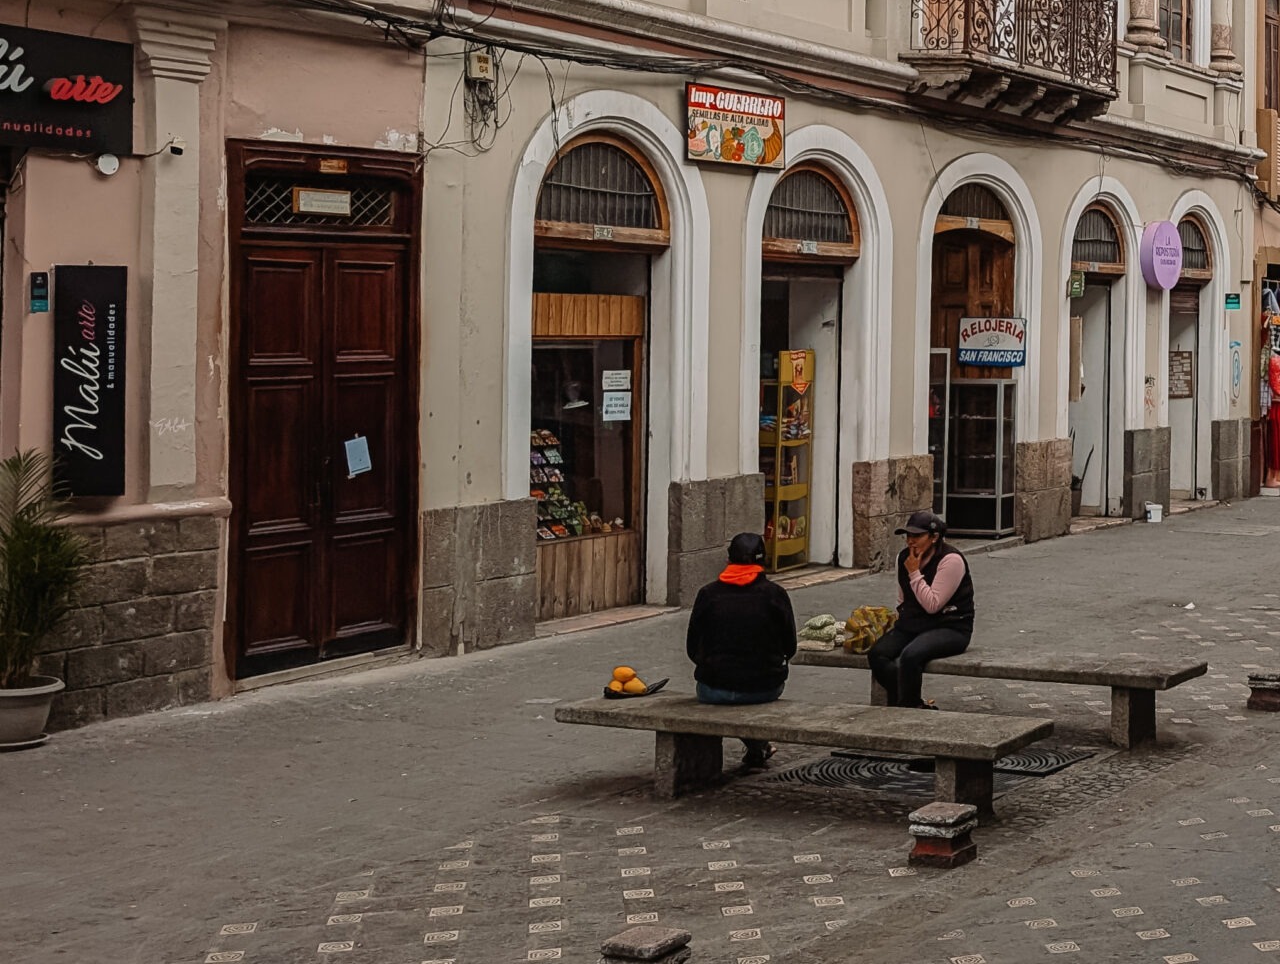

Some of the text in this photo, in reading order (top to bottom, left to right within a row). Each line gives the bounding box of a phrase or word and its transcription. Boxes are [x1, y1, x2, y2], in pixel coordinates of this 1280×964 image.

[49, 74, 123, 104] arte
[716, 91, 782, 117] GUERRERO
[692, 109, 769, 127] SEMILLAS DE ALTA CALIDAD
[107, 303, 116, 380] manualidades
[961, 319, 1024, 344] RELOJERIA
[959, 349, 1024, 363] SAN FRANCISCO
[60, 299, 104, 460] Malú arte
